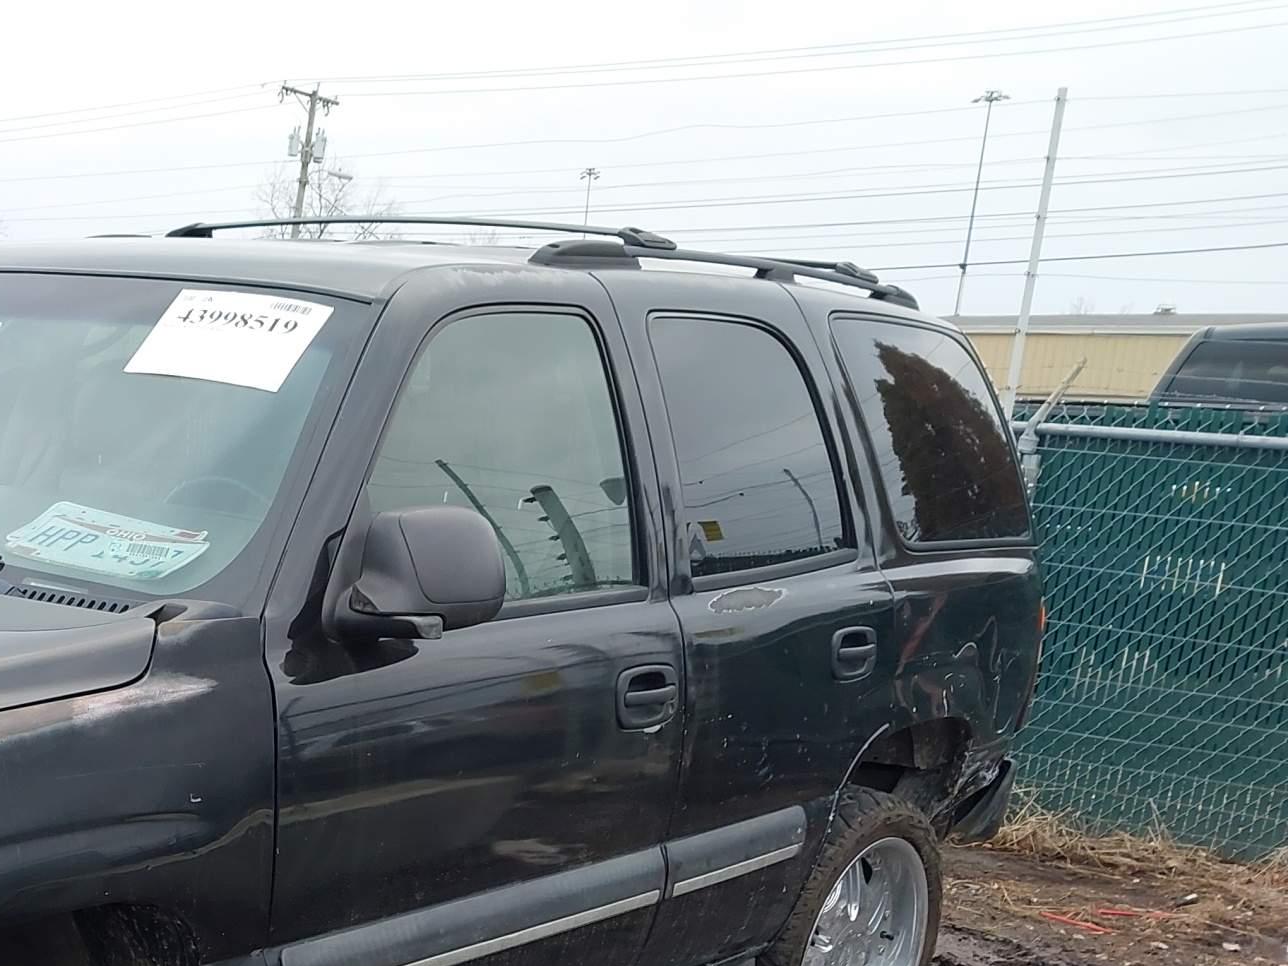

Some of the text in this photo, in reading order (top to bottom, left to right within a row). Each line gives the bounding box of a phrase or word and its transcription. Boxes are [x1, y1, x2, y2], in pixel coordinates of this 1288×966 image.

[177, 308, 298, 334] 43998519
[29, 525, 100, 551] HPP
[106, 527, 147, 541] OHIO
